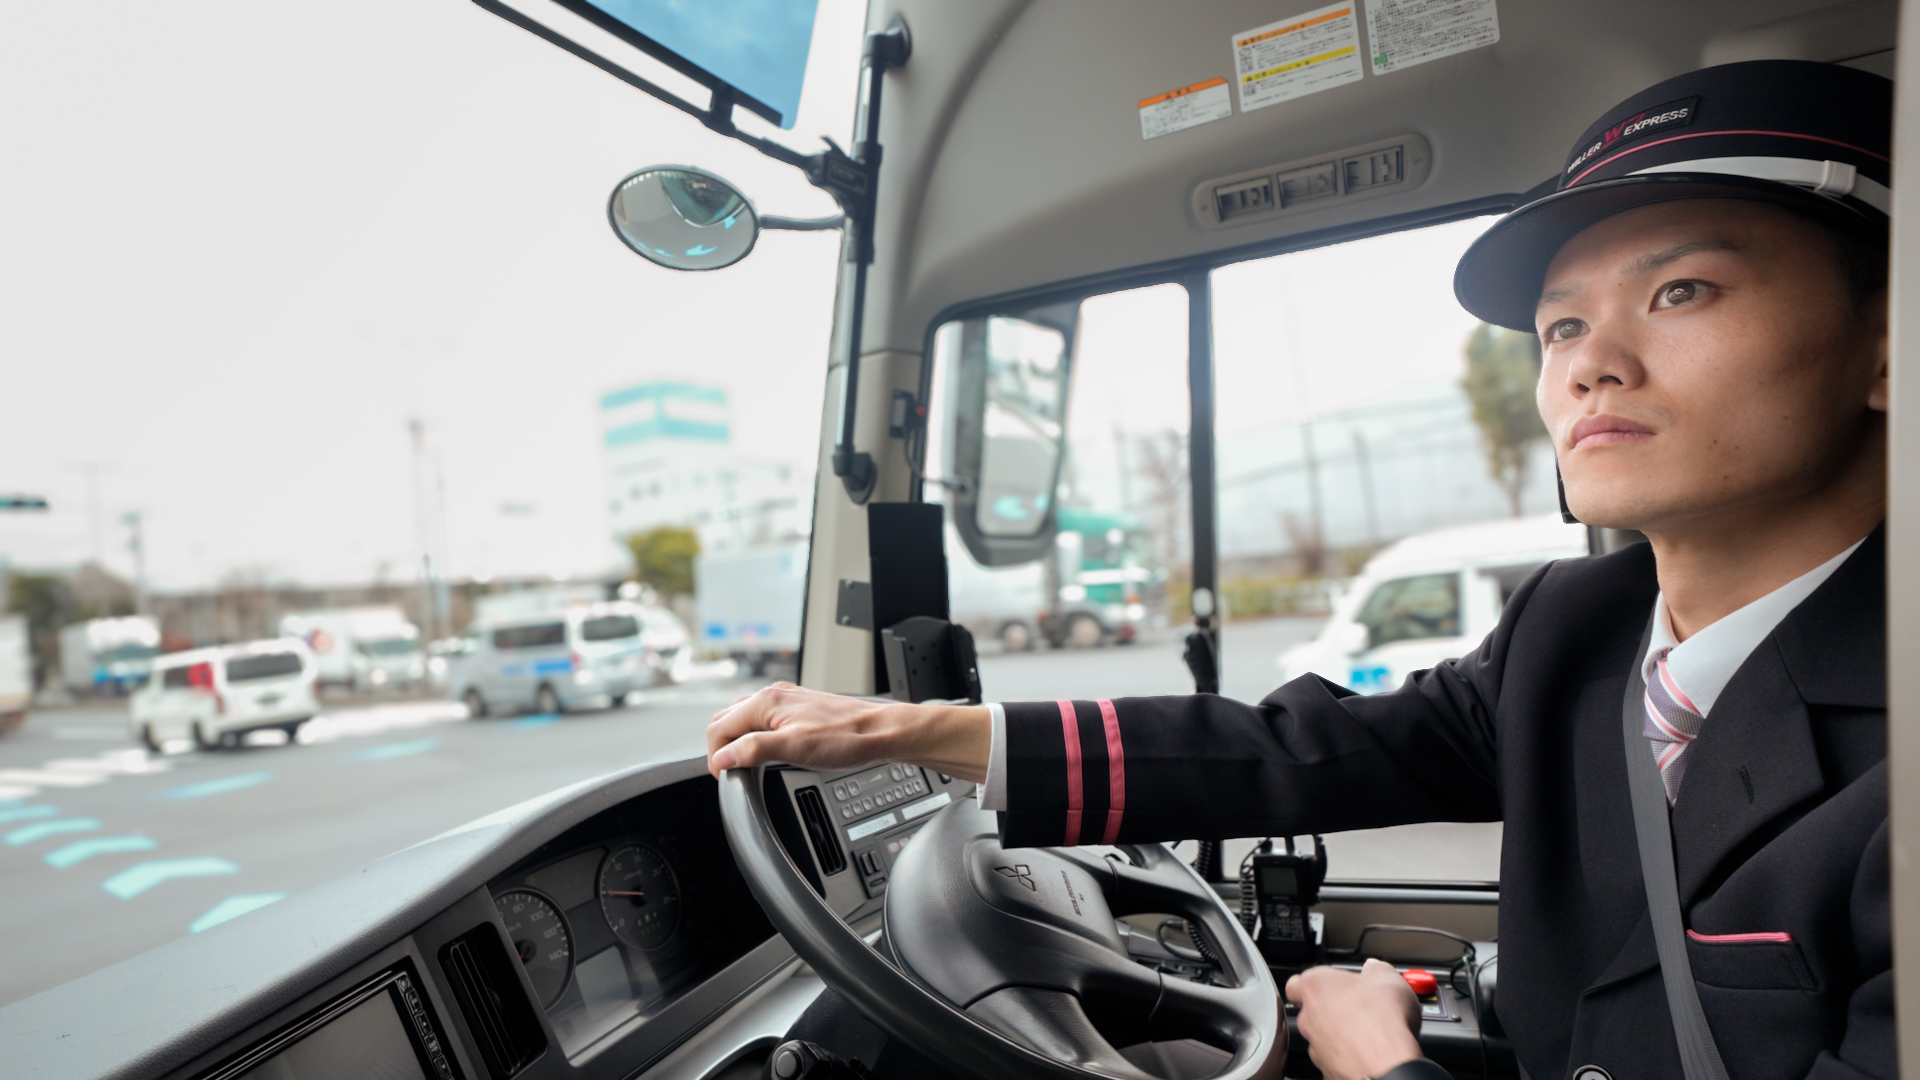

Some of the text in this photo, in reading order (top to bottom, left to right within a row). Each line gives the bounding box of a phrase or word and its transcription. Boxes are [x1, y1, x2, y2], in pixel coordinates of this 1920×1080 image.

[1567, 142, 1602, 173] WILLER
[1623, 108, 1690, 136] EXPRESS
[512, 902, 525, 914] 80
[529, 910, 544, 922] 100
[543, 927, 557, 939] 120
[549, 949, 563, 961] 140
